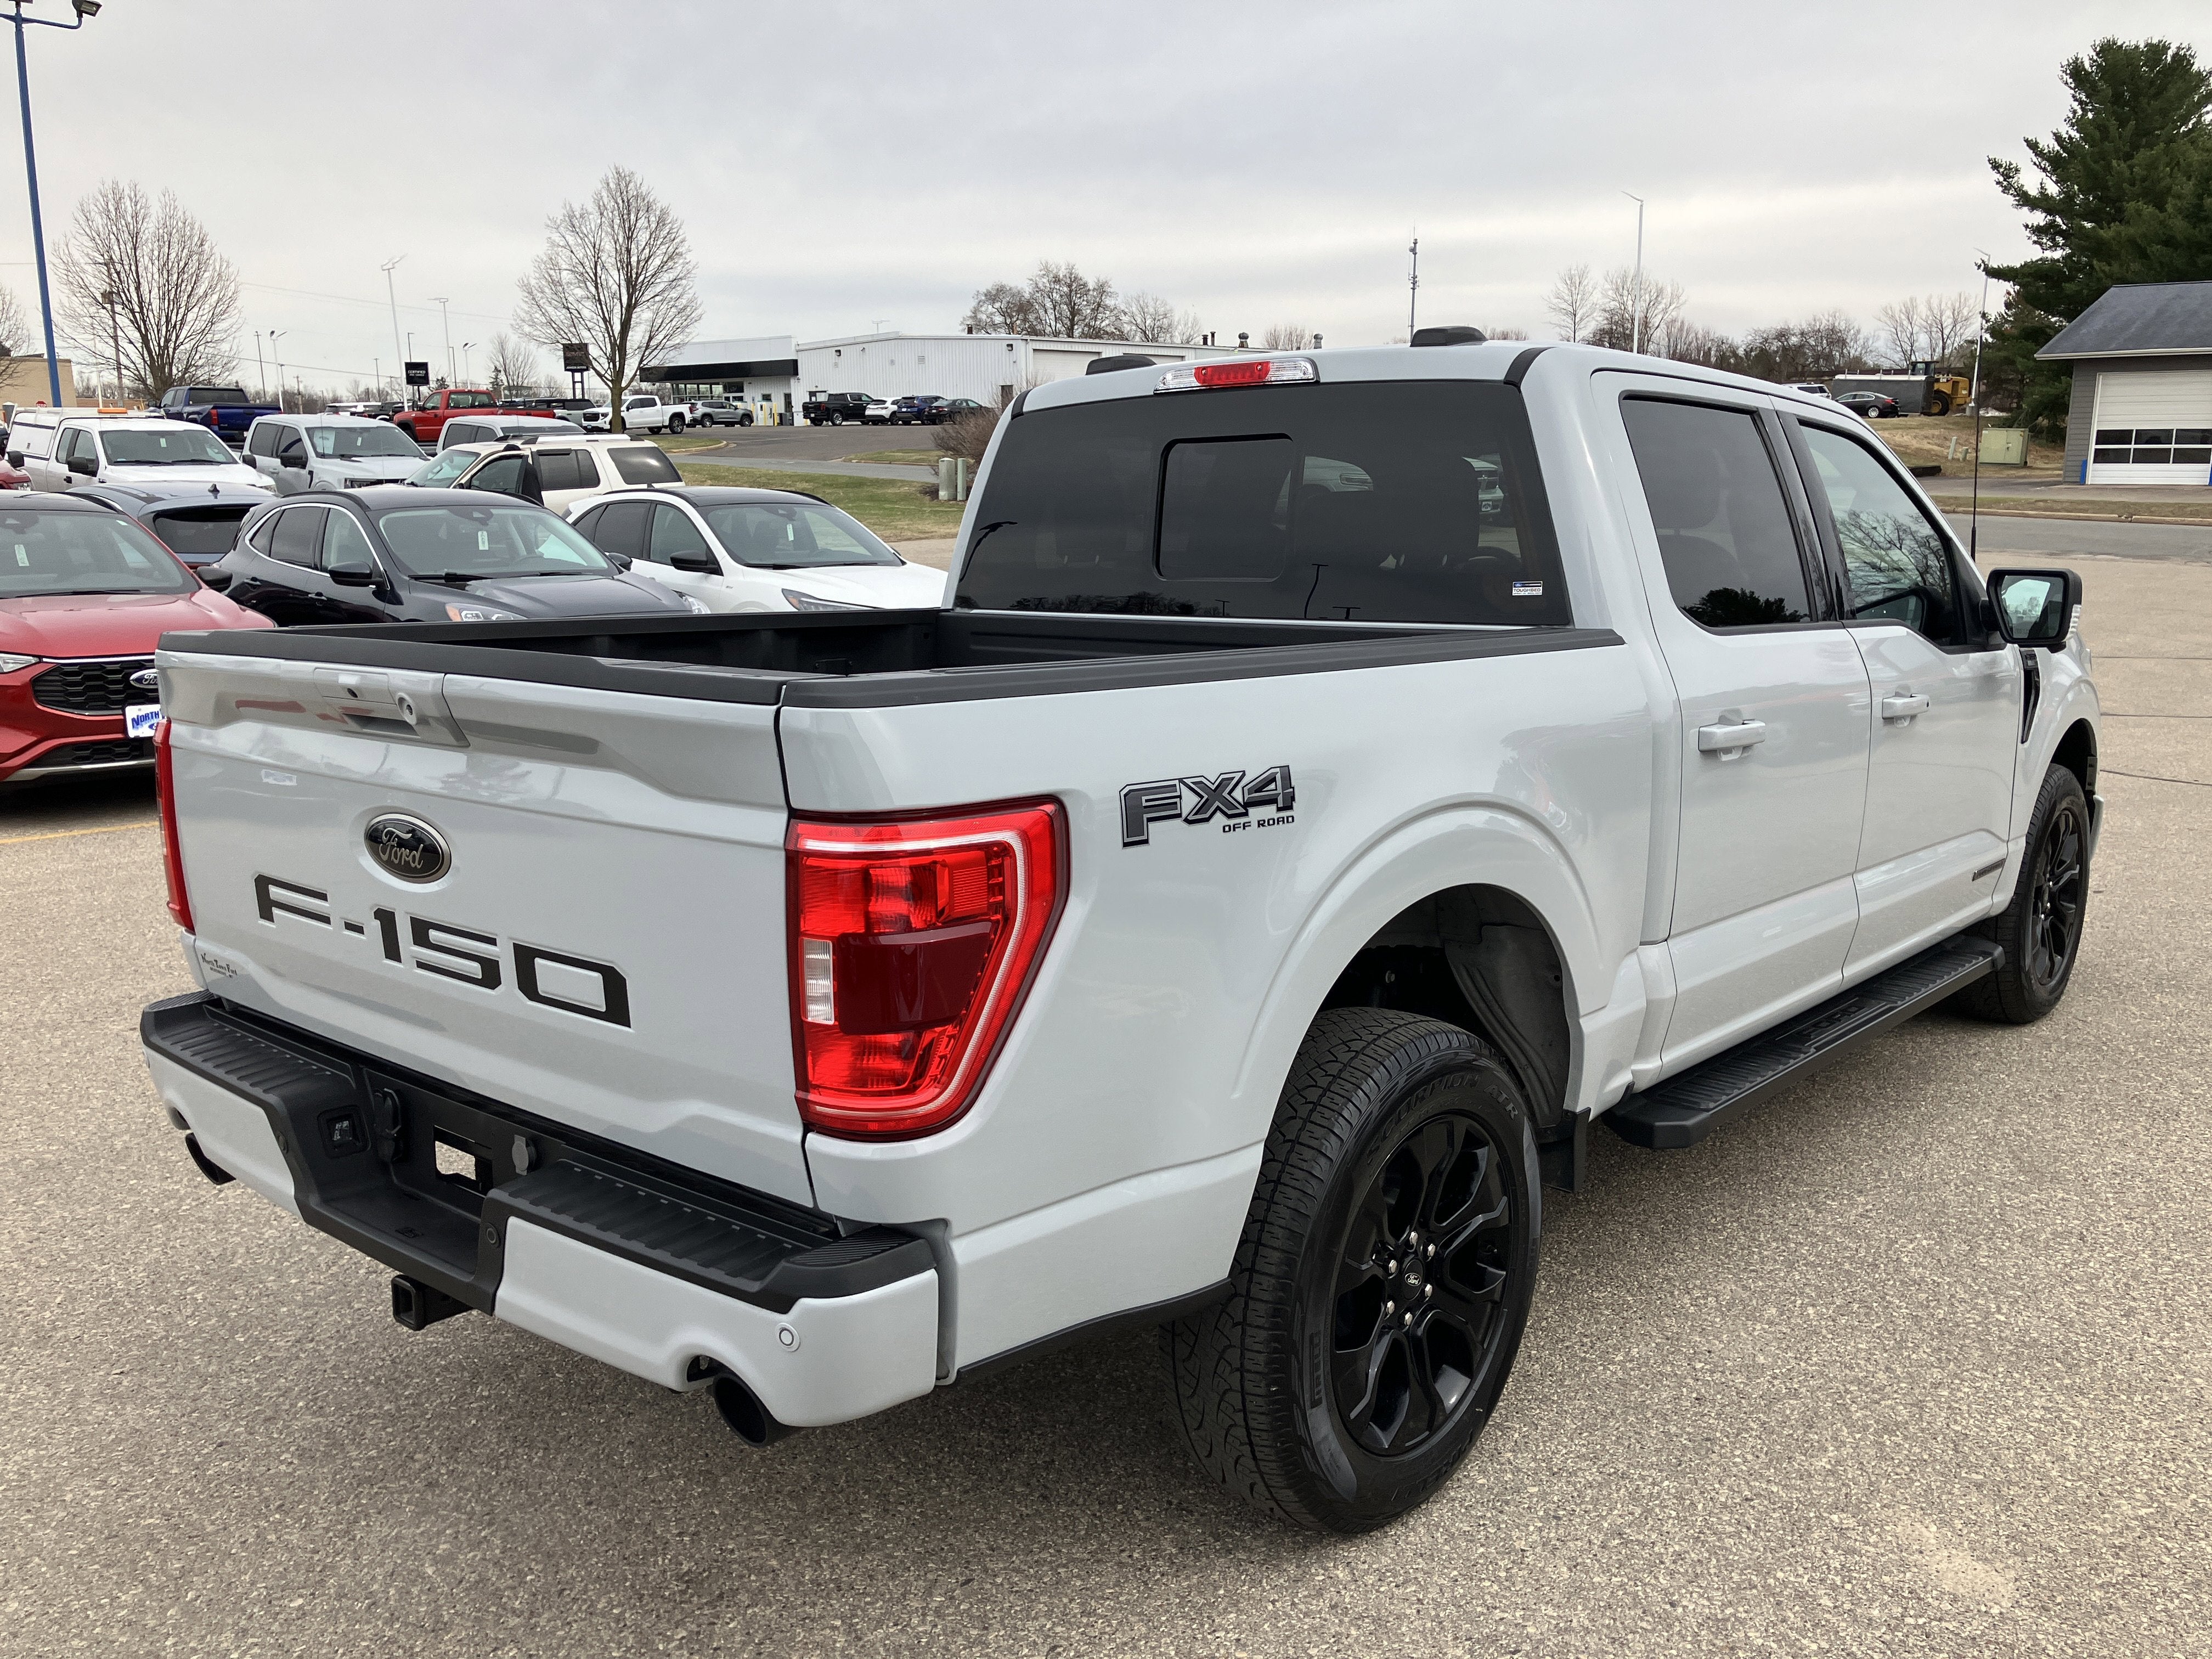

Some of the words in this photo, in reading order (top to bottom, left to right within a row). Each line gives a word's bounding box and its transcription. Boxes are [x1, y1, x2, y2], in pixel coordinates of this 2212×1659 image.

[142, 673, 158, 685] Fo
[131, 710, 160, 730] NORTH
[1119, 765, 1296, 849] FX4
[1222, 821, 1251, 833] OFF
[1257, 815, 1295, 828] ROAD
[379, 827, 424, 869] Ford
[254, 874, 631, 1028] F-150
